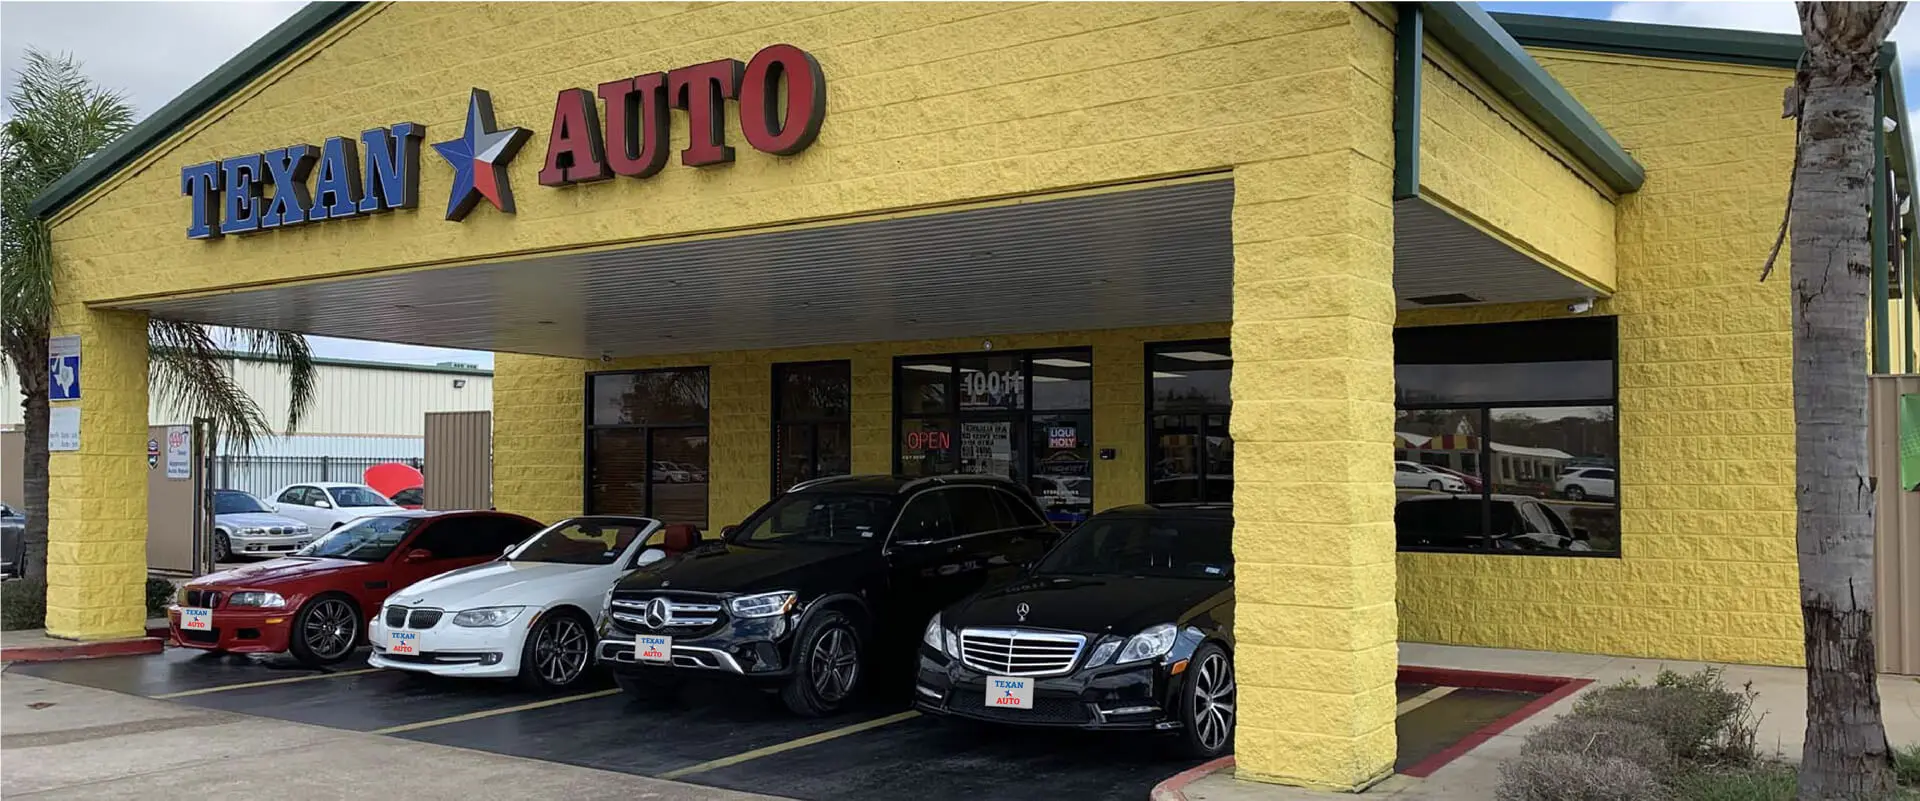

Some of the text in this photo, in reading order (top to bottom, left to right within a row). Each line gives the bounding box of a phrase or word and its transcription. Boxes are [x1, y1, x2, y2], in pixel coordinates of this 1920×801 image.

[181, 43, 827, 240] TEXAN AUTO
[964, 370, 1021, 396] 10011
[908, 432, 950, 449] OPEN
[1050, 438, 1075, 447] MOLY
[995, 680, 1024, 688] TEXAN
[996, 697, 1021, 705] AUTO
